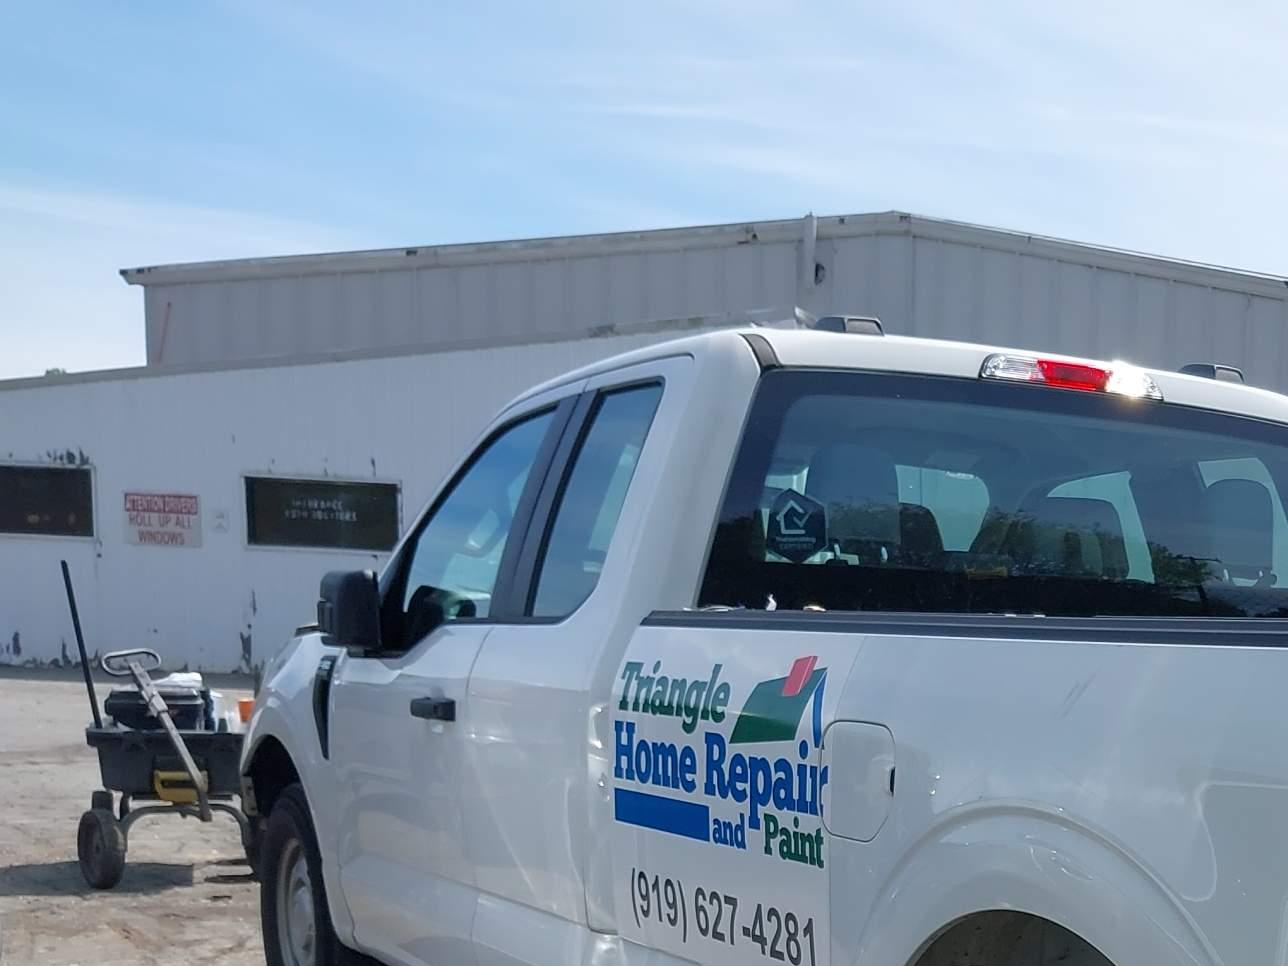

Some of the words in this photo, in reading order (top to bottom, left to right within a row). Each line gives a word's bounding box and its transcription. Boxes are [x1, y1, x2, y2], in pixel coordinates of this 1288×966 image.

[126, 495, 164, 512] ATTENTION
[128, 511, 153, 527] ROLL
[159, 513, 171, 528] UP
[175, 514, 192, 530] ALL
[138, 530, 185, 545] WINDOWS
[619, 660, 731, 734] Triangle
[614, 720, 697, 793] Home
[704, 732, 829, 831] Repair
[712, 813, 747, 850] and
[763, 812, 825, 869] Paint
[631, 867, 688, 943] (919)
